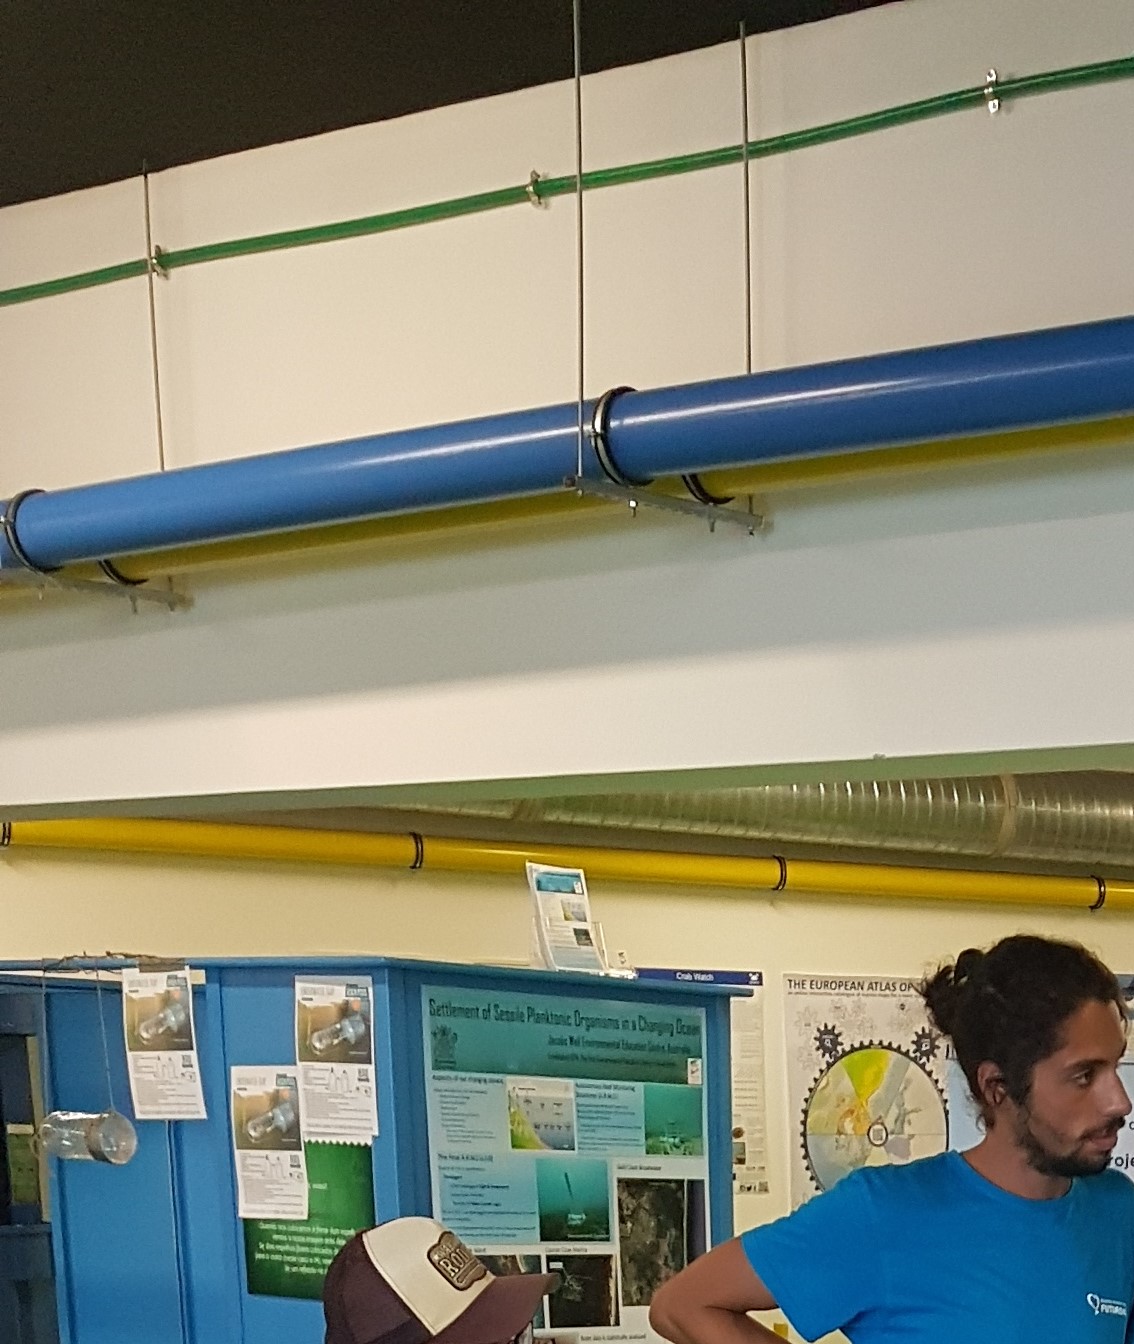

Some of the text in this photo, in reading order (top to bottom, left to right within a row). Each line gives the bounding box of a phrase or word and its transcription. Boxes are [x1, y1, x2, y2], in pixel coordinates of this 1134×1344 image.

[787, 979, 896, 992] THE EUROPEAN ATLAS
[429, 999, 480, 1020] Settlement
[482, 1003, 492, 1020] of
[527, 1007, 572, 1027] Planktonic
[574, 1010, 620, 1032] Organisms
[638, 1015, 674, 1037] Changing
